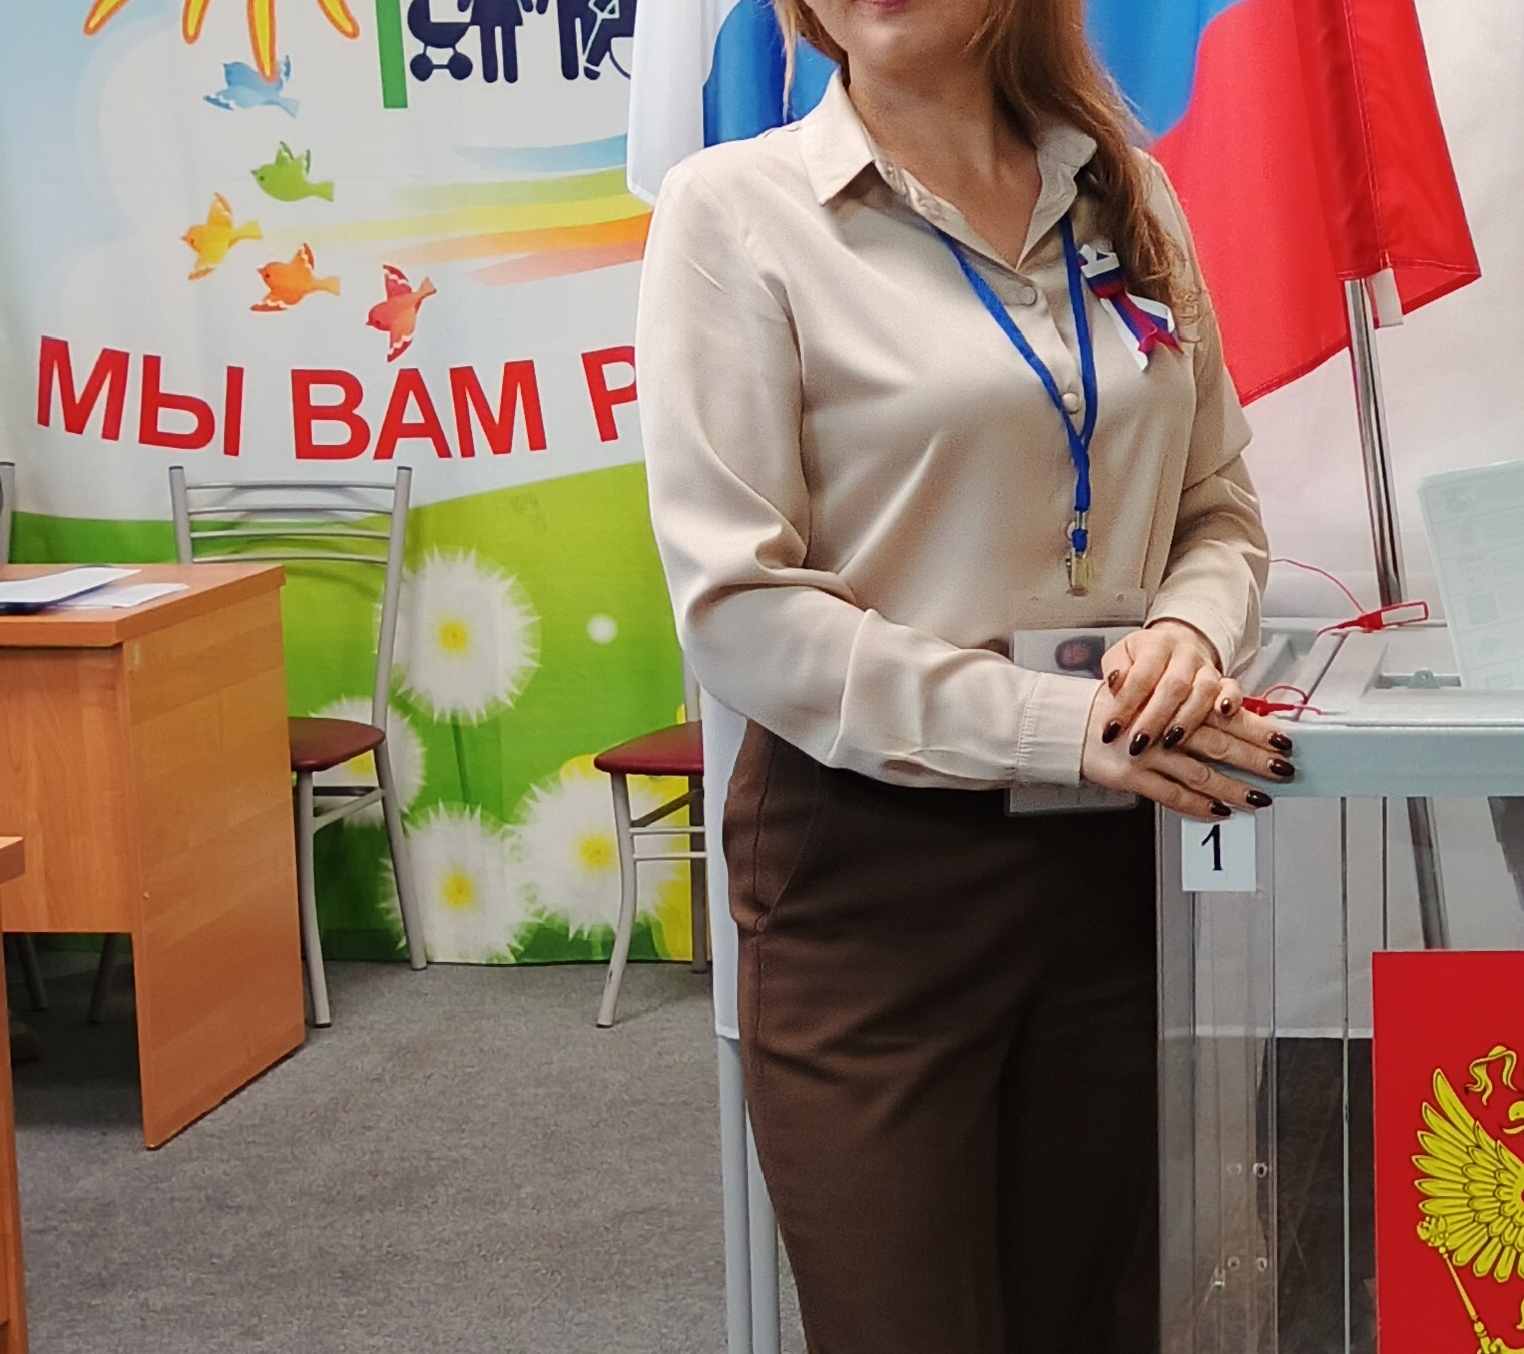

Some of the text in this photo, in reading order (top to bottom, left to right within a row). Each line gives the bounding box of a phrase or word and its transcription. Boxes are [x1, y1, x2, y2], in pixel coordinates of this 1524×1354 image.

[36, 334, 244, 458] МЫ
[290, 358, 548, 461] ВАМ
[1201, 823, 1224, 871] 1
